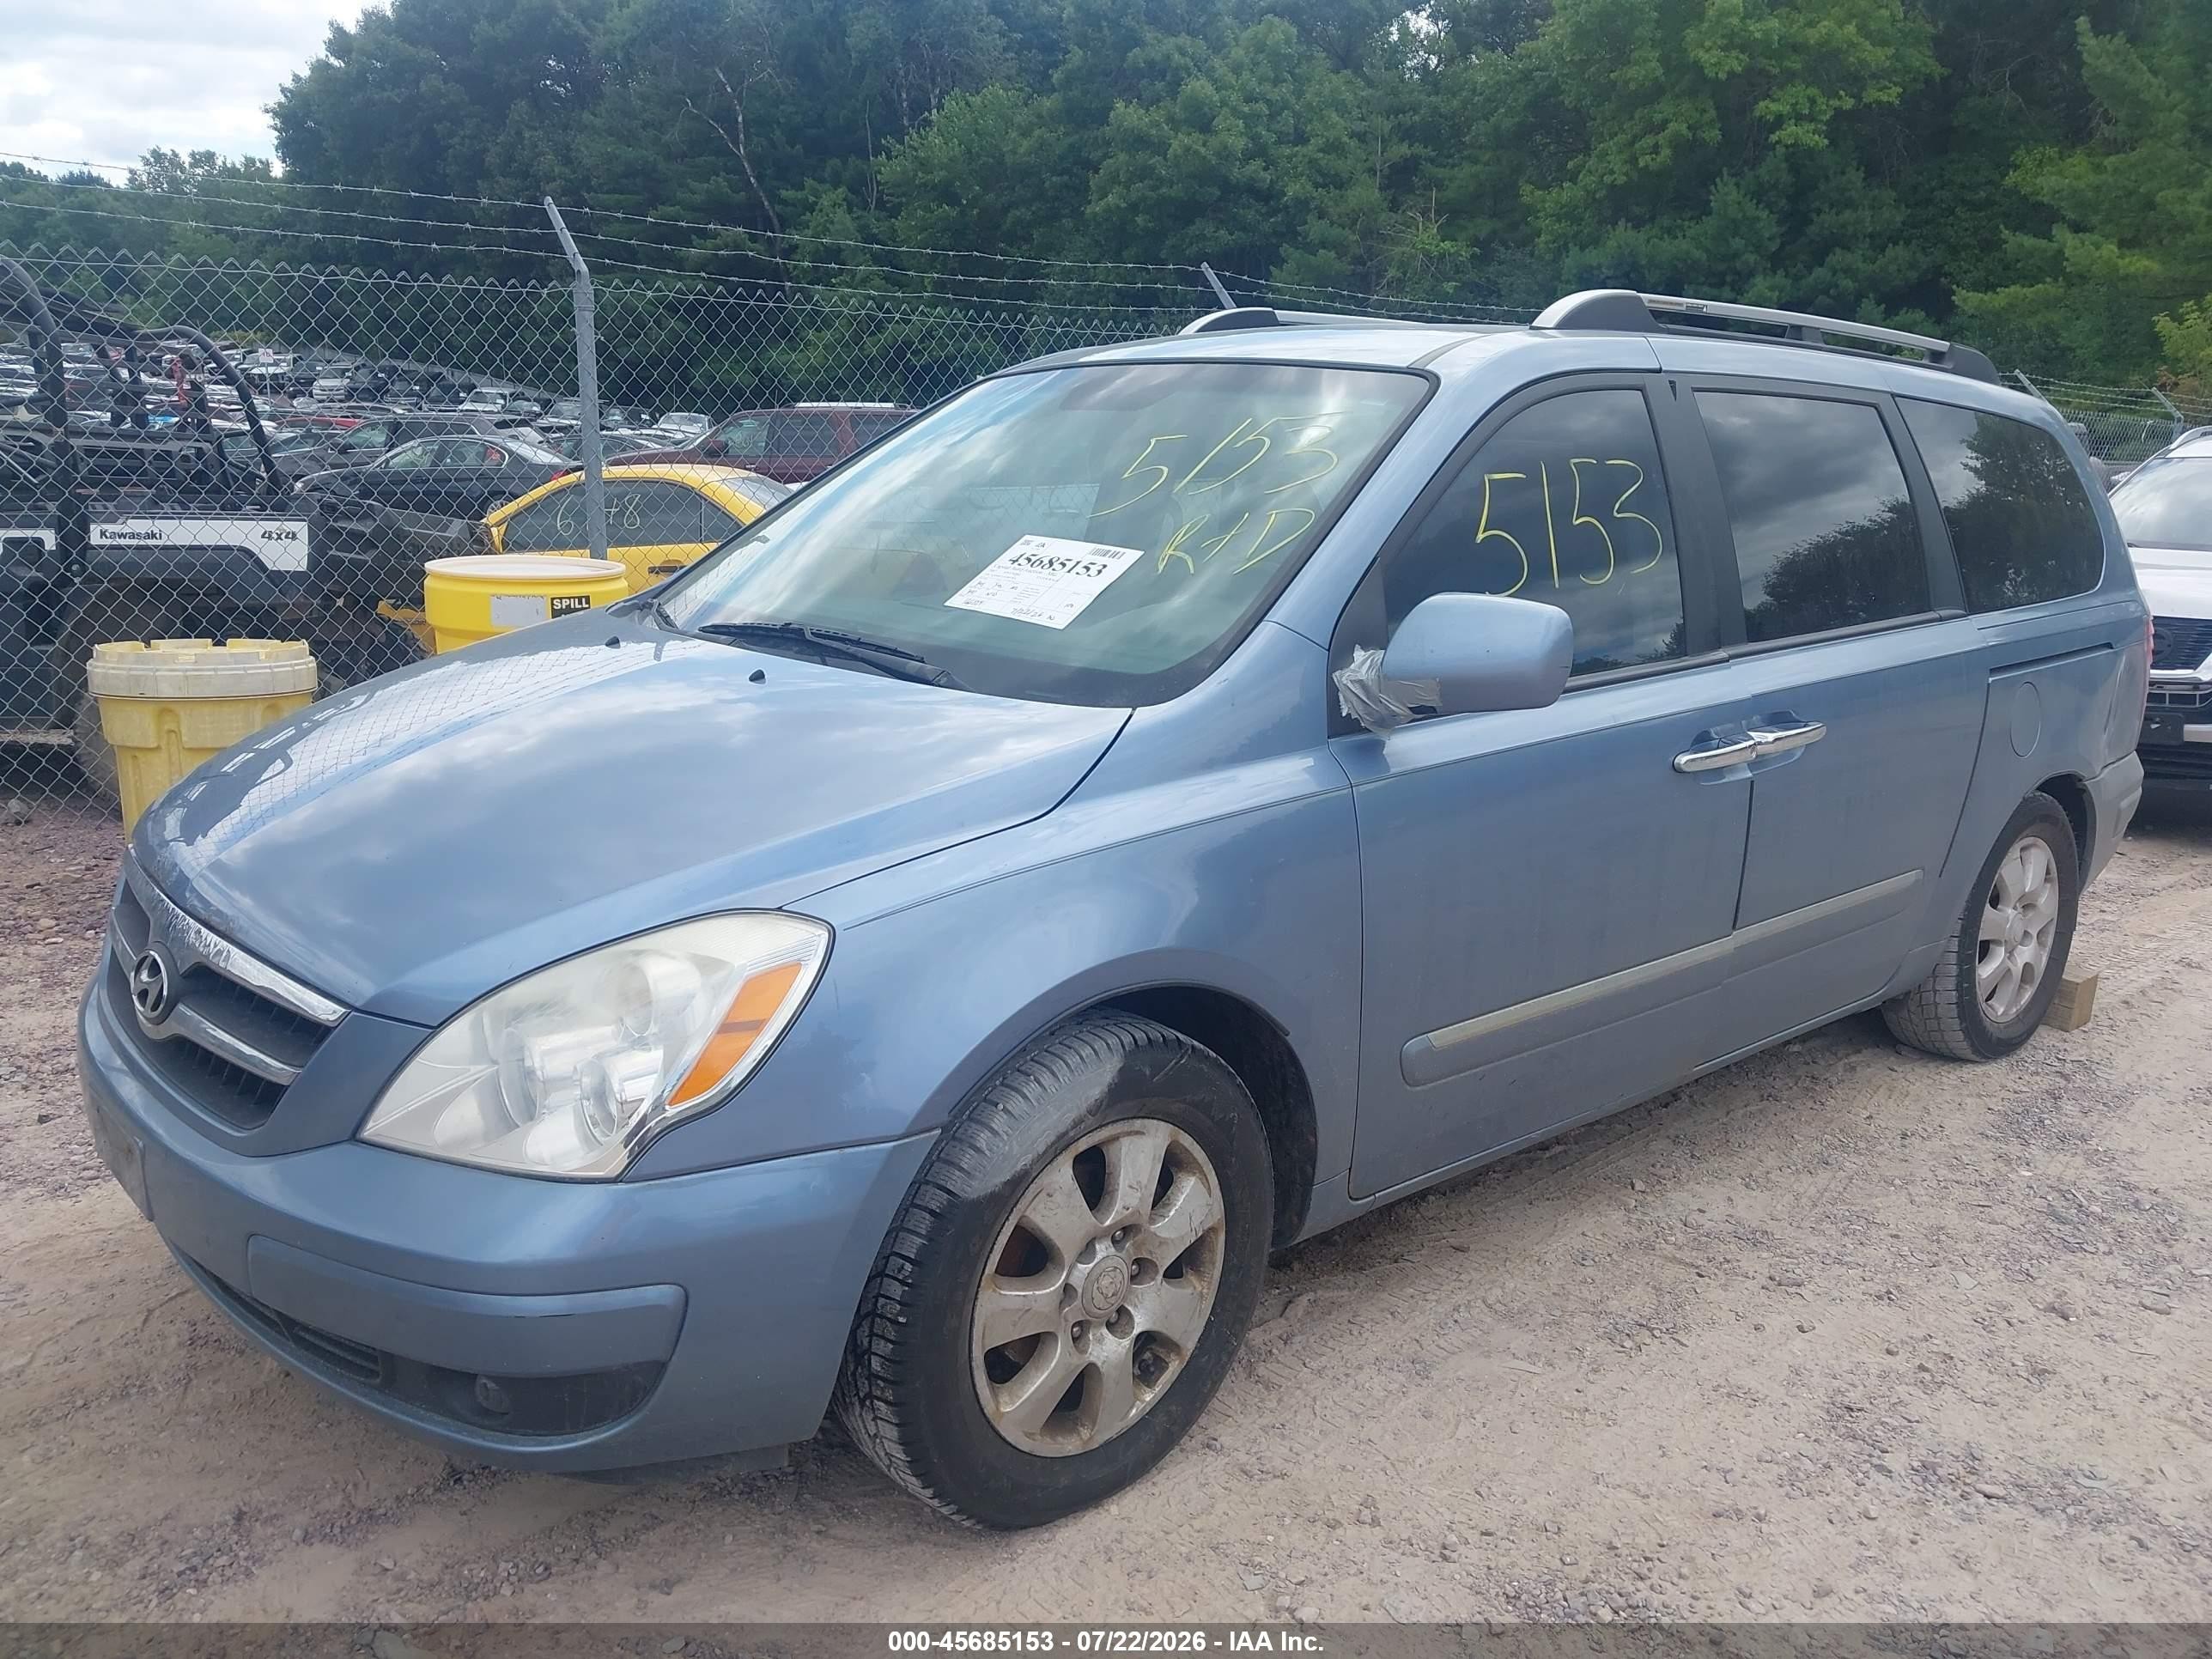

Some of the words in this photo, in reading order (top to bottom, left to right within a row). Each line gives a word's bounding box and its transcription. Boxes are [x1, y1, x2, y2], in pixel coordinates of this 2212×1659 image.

[1087, 411, 1352, 519] 5153
[99, 528, 163, 541] Kawasaki
[1474, 457, 1663, 598] 5153
[1008, 552, 1109, 578] 45685153
[553, 598, 590, 610] SPILL
